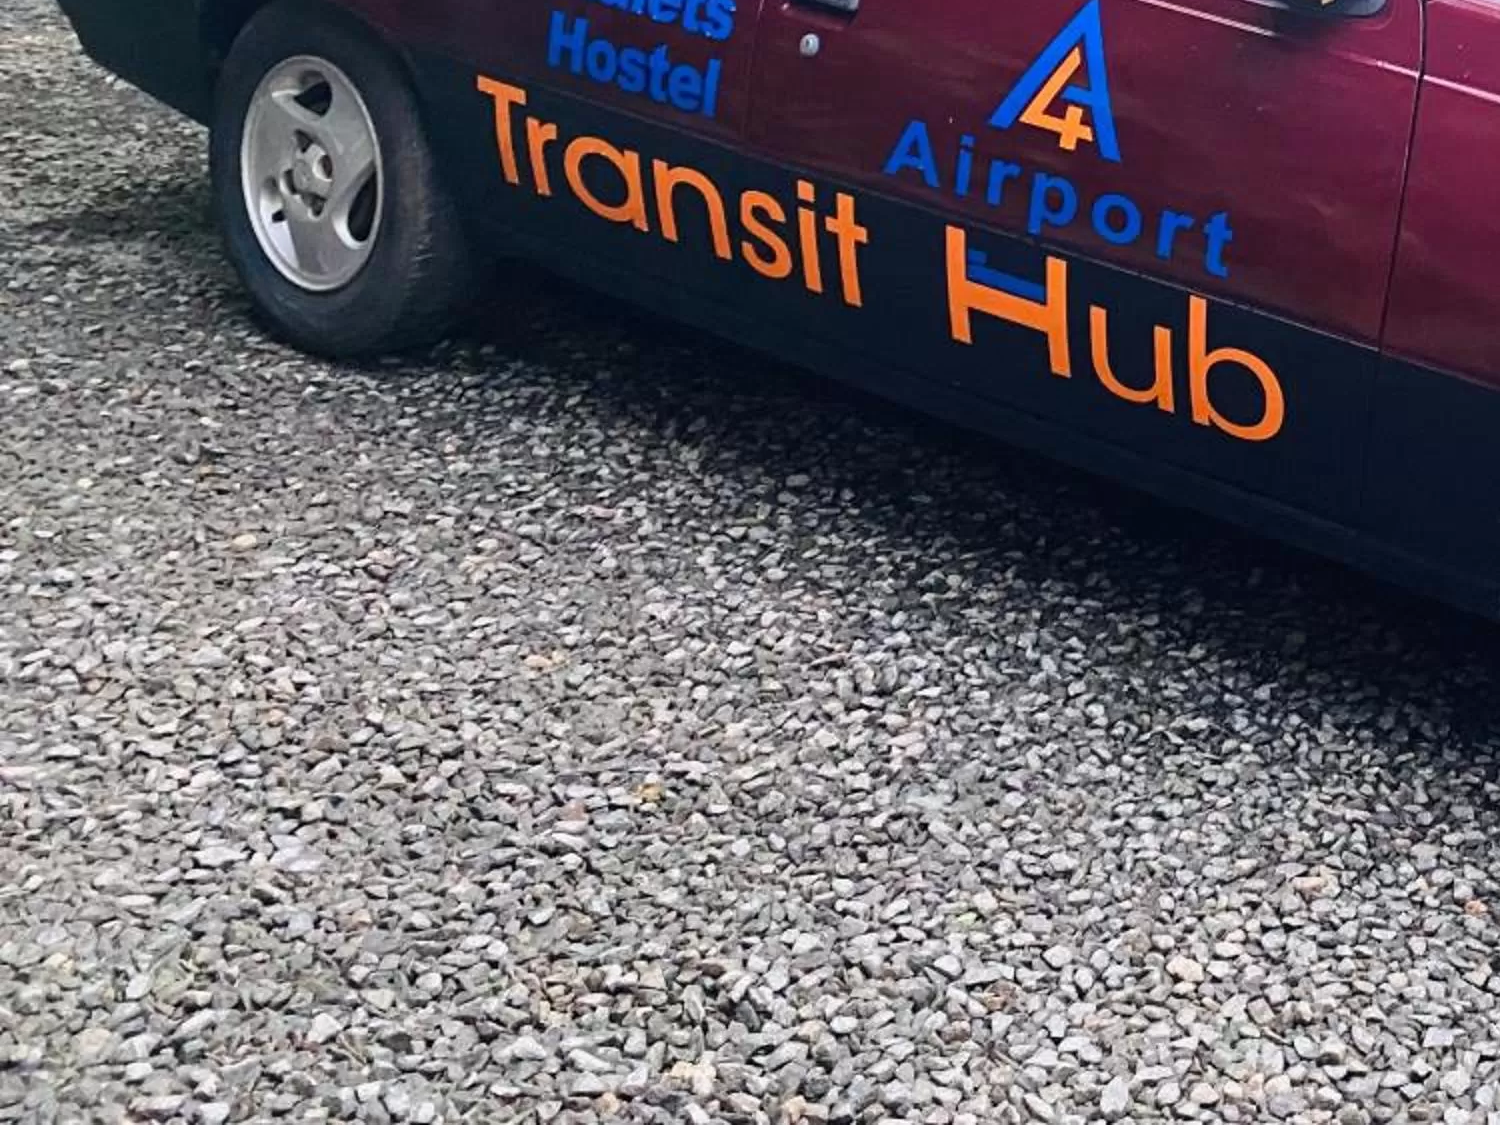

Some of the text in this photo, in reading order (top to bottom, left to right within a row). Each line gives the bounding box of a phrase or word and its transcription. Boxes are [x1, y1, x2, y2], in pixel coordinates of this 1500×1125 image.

[547, 10, 722, 118] Hostel
[476, 75, 1286, 442] Transit Hub
[884, 120, 1234, 278] Airport
